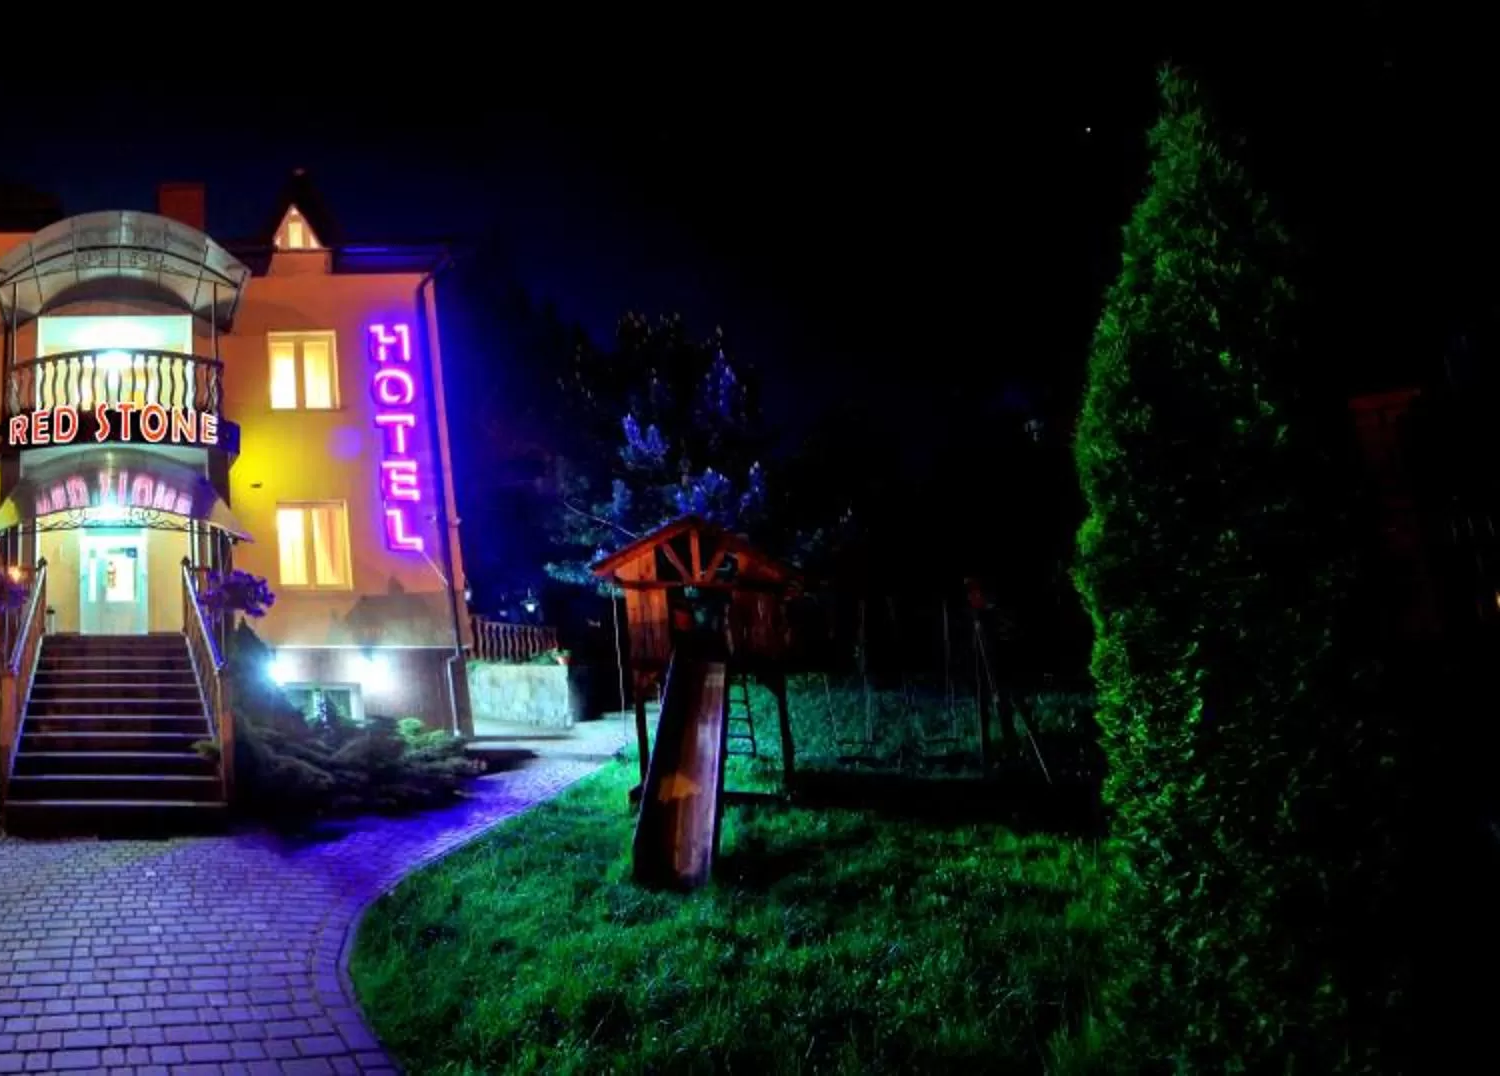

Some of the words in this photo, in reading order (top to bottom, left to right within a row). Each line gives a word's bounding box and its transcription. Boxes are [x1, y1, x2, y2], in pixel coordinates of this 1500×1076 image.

[8, 404, 79, 445] RED
[94, 402, 219, 445] STONE
[369, 323, 425, 552] HOTEL
